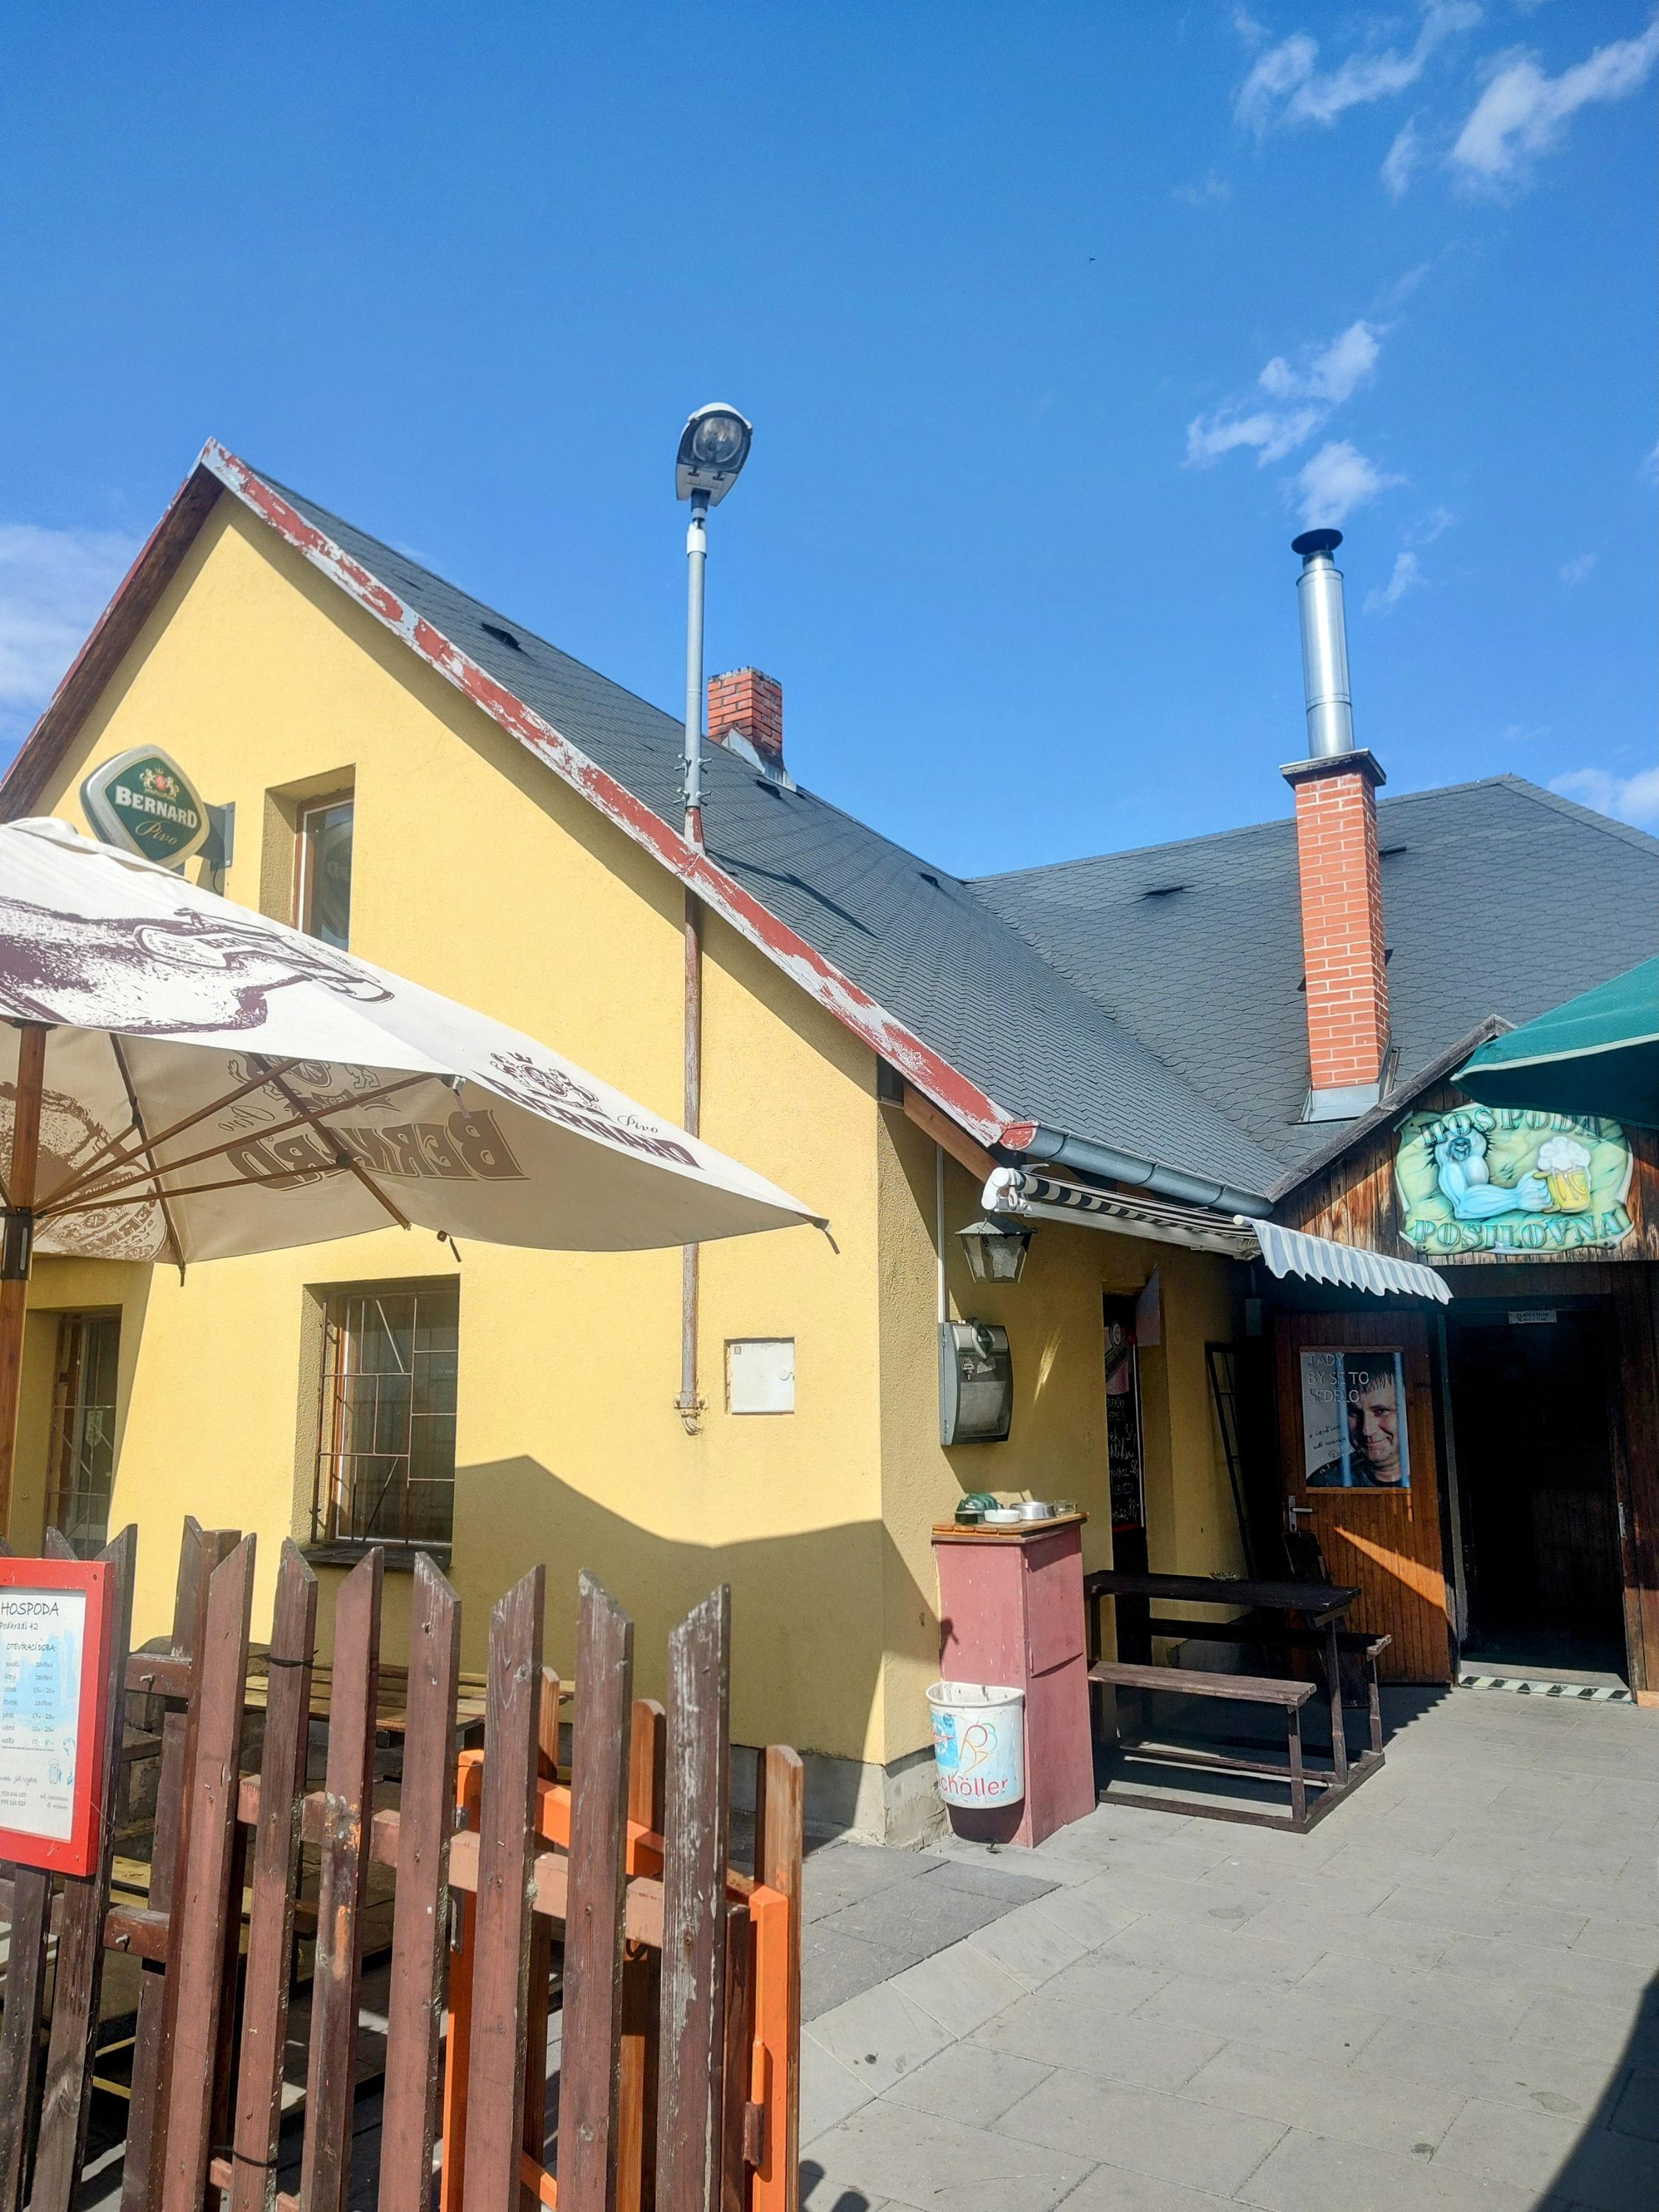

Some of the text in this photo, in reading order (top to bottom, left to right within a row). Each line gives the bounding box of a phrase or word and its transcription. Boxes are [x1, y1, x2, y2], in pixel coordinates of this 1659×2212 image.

[114, 785, 198, 829] BERNARD
[135, 820, 178, 846] Pivo
[616, 1114, 659, 1134] Pivo
[1418, 1107, 1601, 1145] HOSPODA
[1414, 1209, 1626, 1248] POSILOVNA
[1306, 1353, 1345, 1366] TADY
[1309, 1371, 1369, 1385] BY SE TO
[1, 1601, 59, 1616] HOSPODA
[937, 1774, 1008, 1798] chöller
